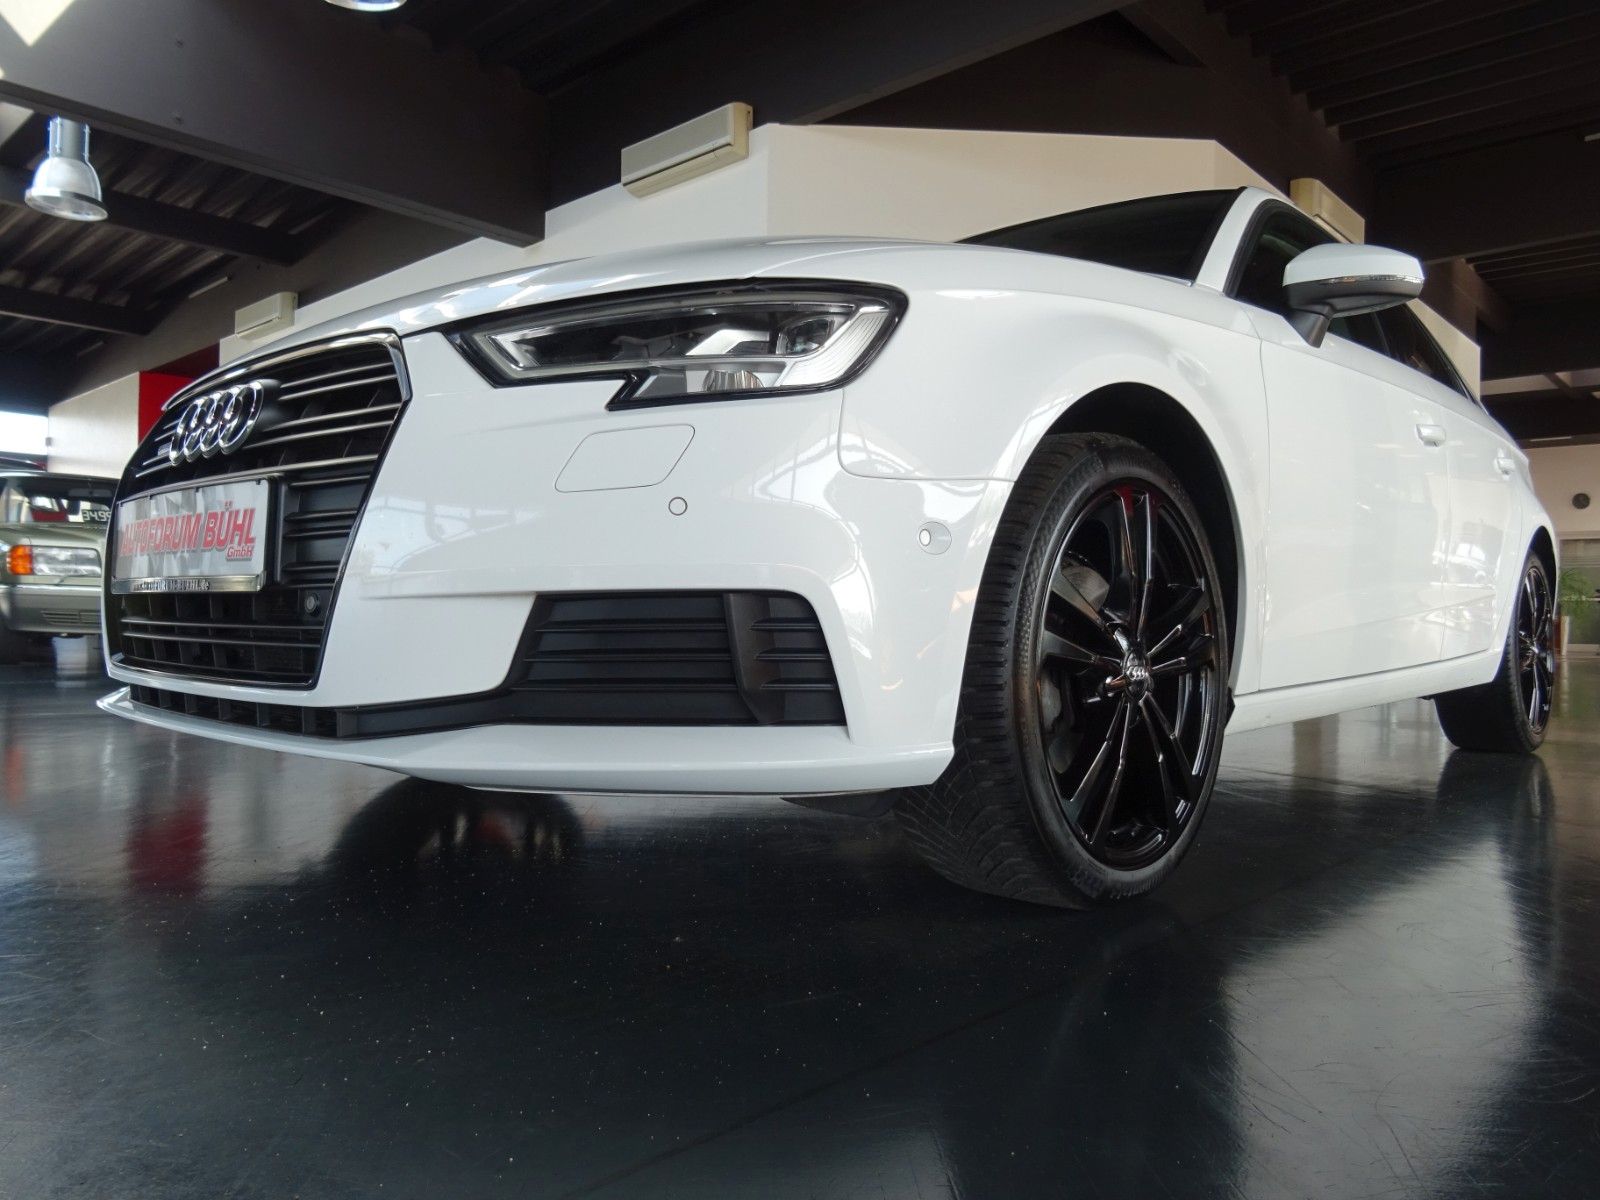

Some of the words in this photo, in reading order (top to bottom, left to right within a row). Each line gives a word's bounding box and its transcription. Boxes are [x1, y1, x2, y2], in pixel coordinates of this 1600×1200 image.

[119, 512, 203, 557] AUTOFORUM
[203, 501, 256, 551] BÜHL
[226, 546, 254, 558] GmbH
